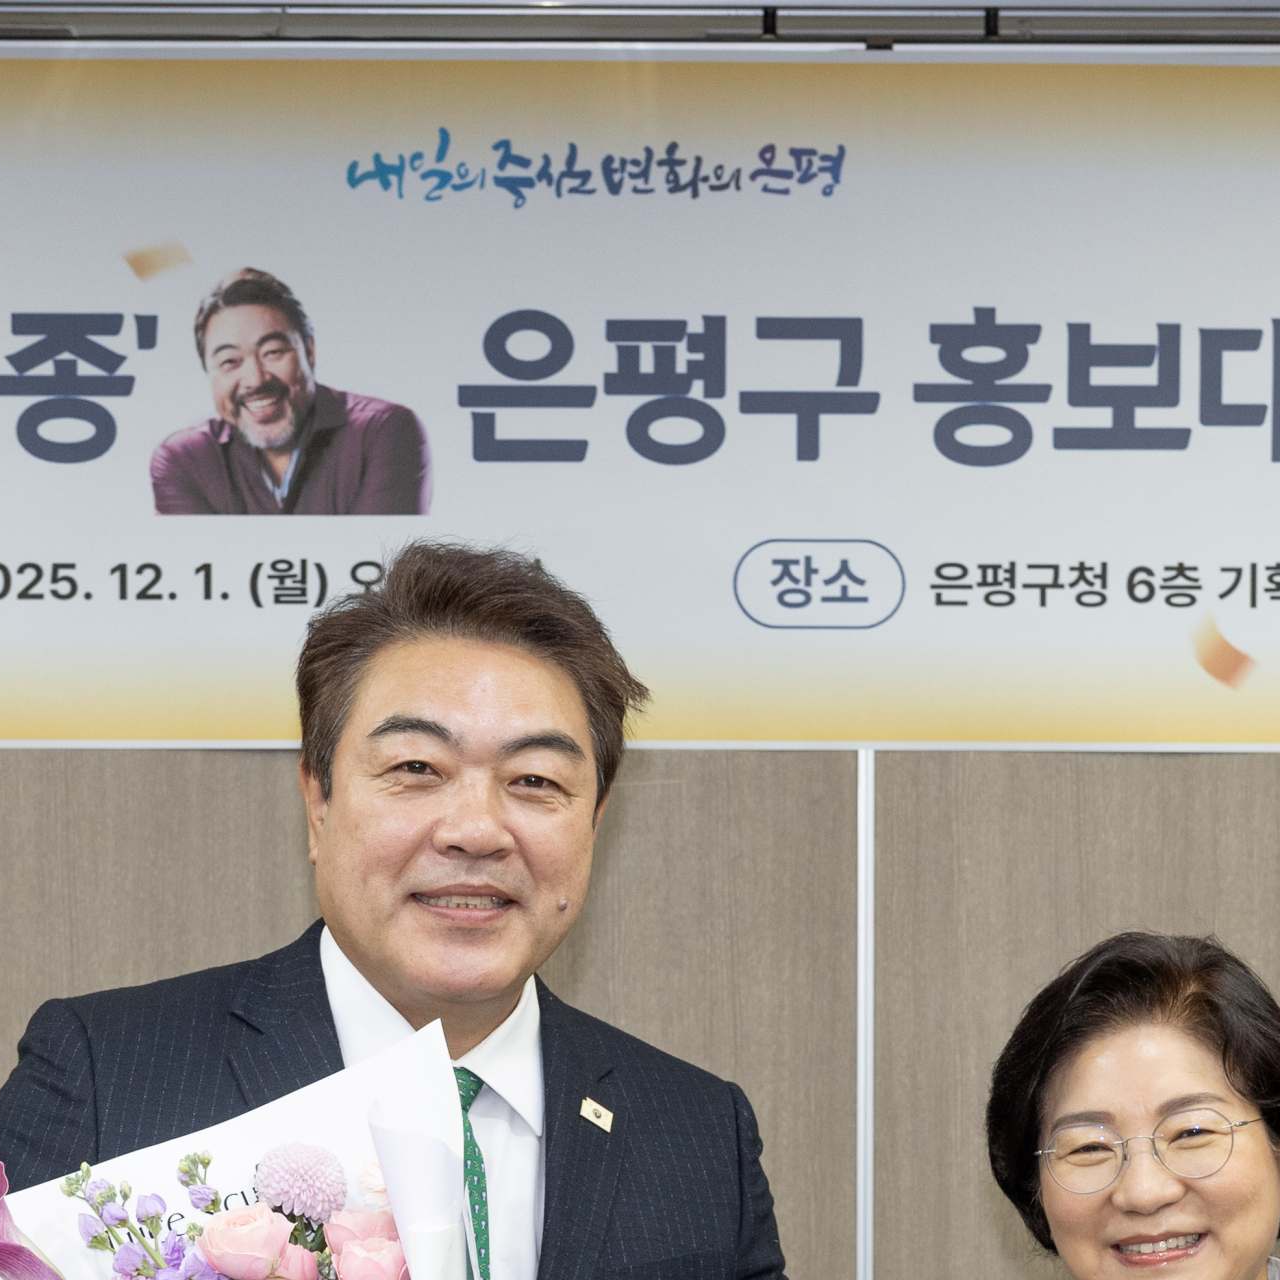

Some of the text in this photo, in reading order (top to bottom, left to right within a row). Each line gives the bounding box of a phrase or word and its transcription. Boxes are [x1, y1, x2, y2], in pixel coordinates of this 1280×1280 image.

[347, 127, 846, 208] 내일의 중심 변화의 은평
[458, 308, 881, 466] 은평구
[110, 562, 177, 601] 12.
[194, 562, 230, 601] 1.
[249, 558, 328, 609] (월)
[769, 555, 869, 609] 장소
[930, 561, 1108, 608] 은평구청
[1126, 561, 1203, 608] 6층
